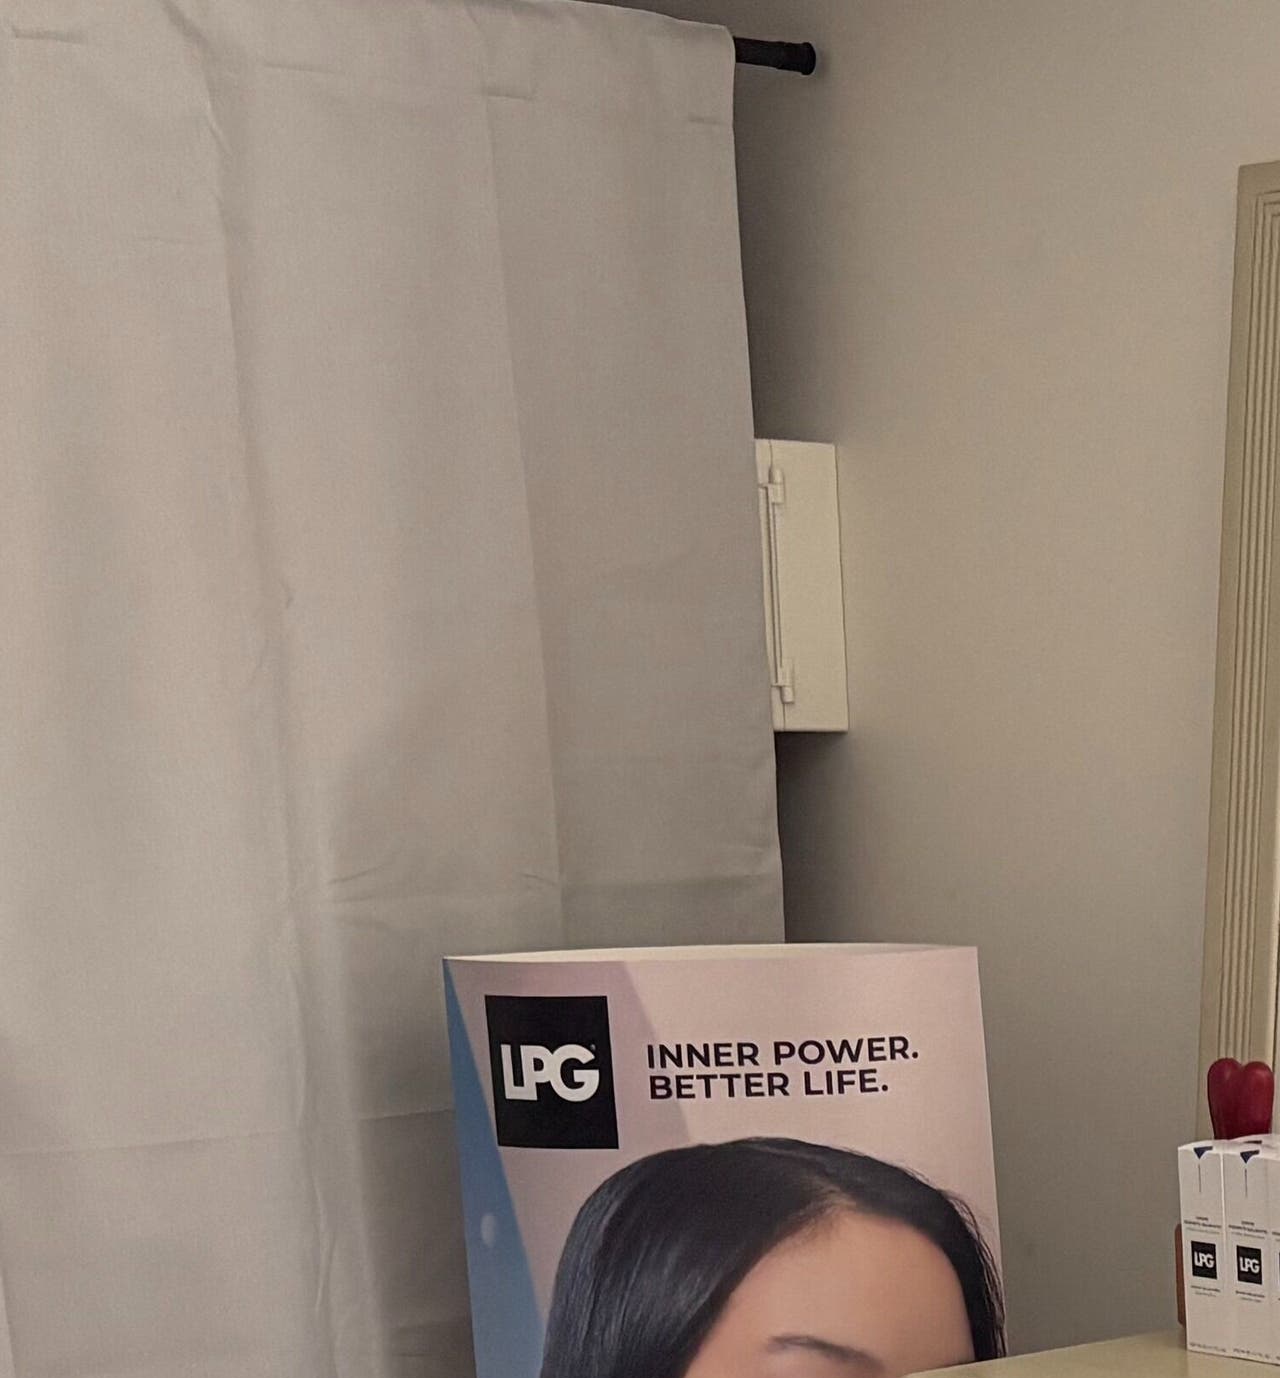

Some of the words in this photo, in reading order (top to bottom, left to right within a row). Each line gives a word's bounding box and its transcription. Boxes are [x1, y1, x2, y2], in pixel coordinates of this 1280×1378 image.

[647, 1042, 760, 1069] INNER
[774, 1036, 919, 1067] POWER.
[500, 1043, 600, 1102] LPG
[649, 1072, 791, 1100] BETTER
[804, 1068, 889, 1096] LIFE.
[1194, 1251, 1214, 1268] LPG
[1239, 1256, 1260, 1273] LPG
